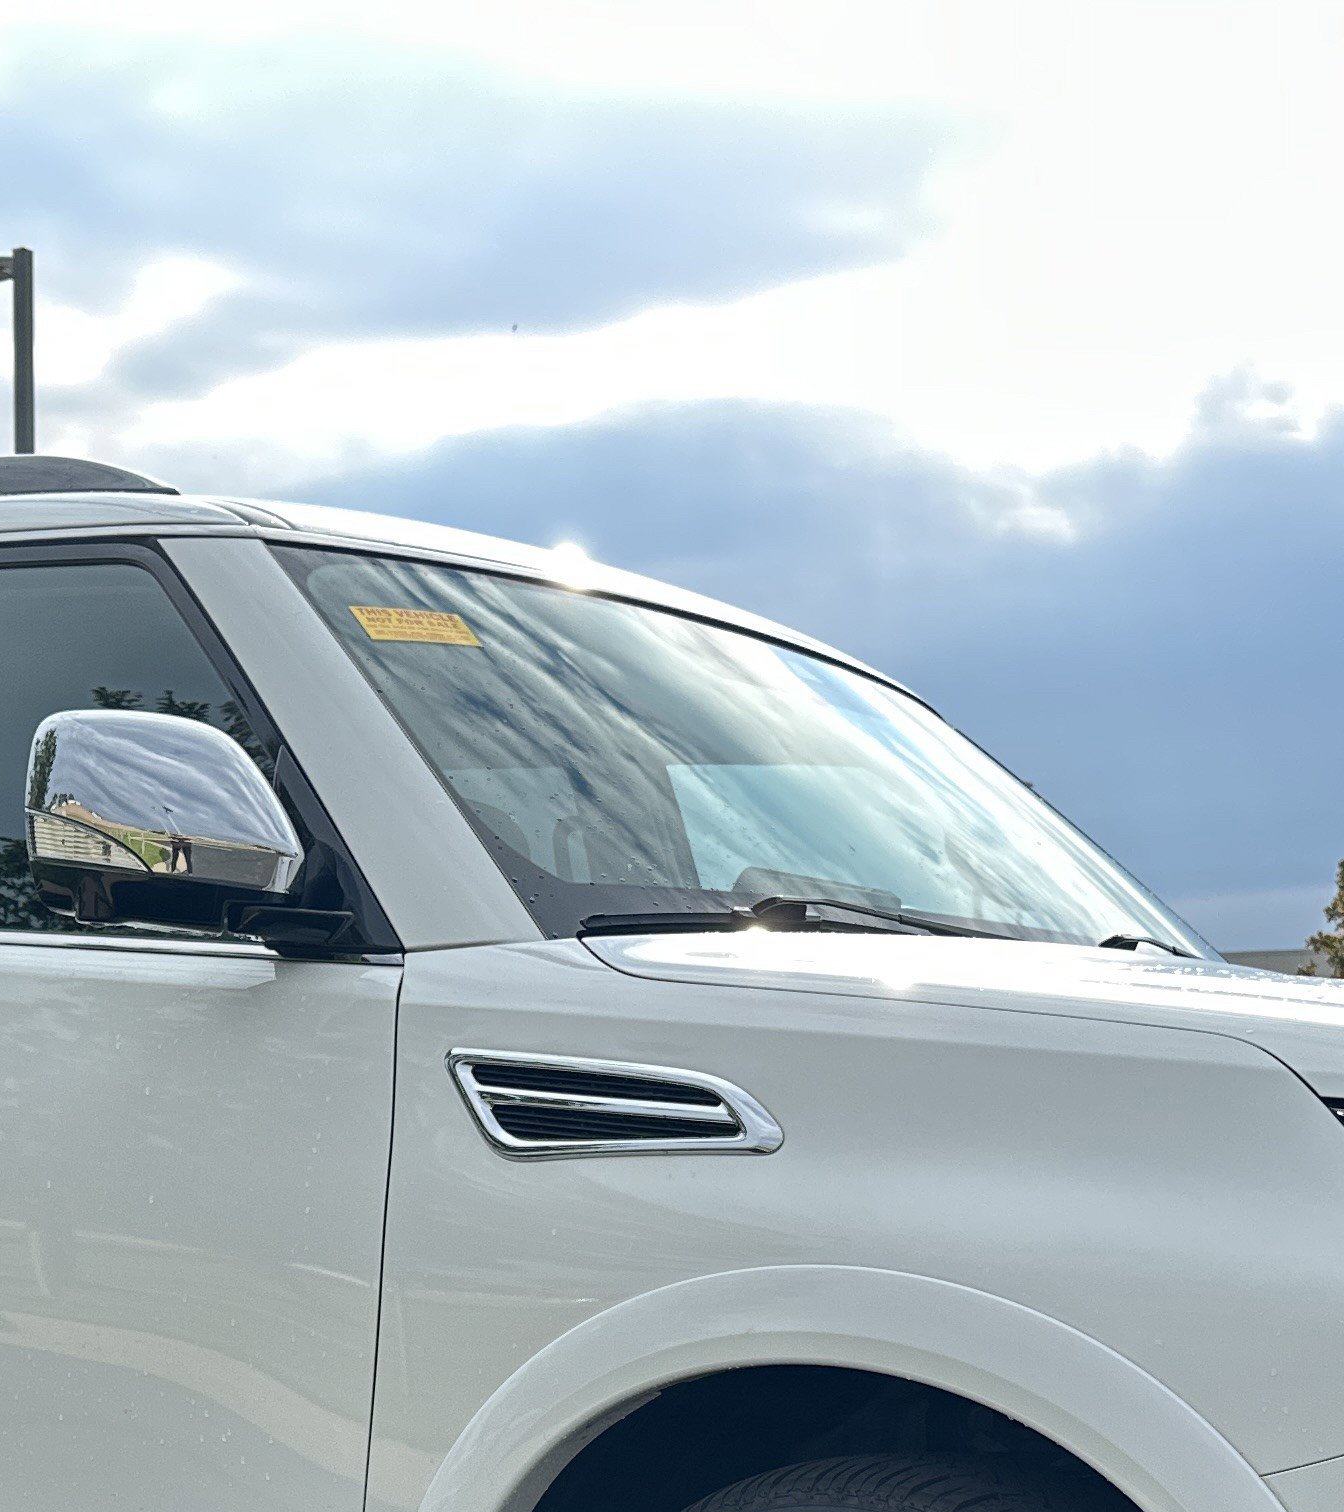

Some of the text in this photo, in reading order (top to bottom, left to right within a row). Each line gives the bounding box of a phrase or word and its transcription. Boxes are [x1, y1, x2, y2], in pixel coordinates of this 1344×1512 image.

[357, 607, 459, 623] THIS VEHICLE
[366, 616, 393, 624] NOT
[396, 618, 424, 627] FOR
[428, 619, 460, 630] SALE
